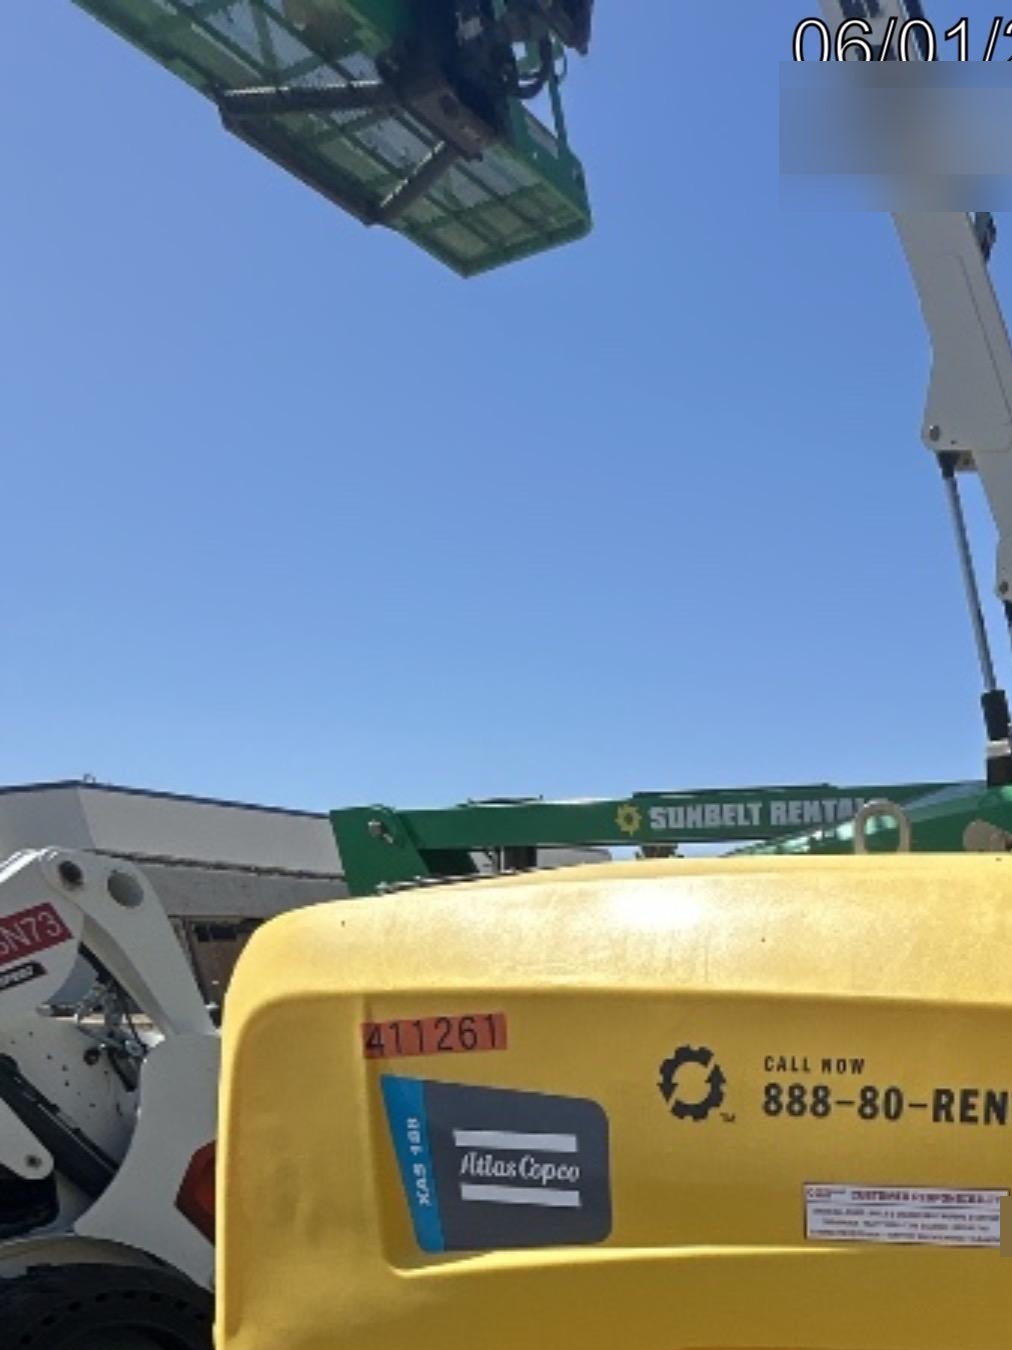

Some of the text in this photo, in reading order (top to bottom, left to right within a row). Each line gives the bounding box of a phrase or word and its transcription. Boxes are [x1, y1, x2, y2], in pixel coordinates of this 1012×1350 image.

[648, 802, 763, 829] SUNBELT
[365, 1014, 502, 1056] 411261
[763, 1055, 866, 1075] CALL NOW
[460, 1151, 581, 1186] Atlas Copco
